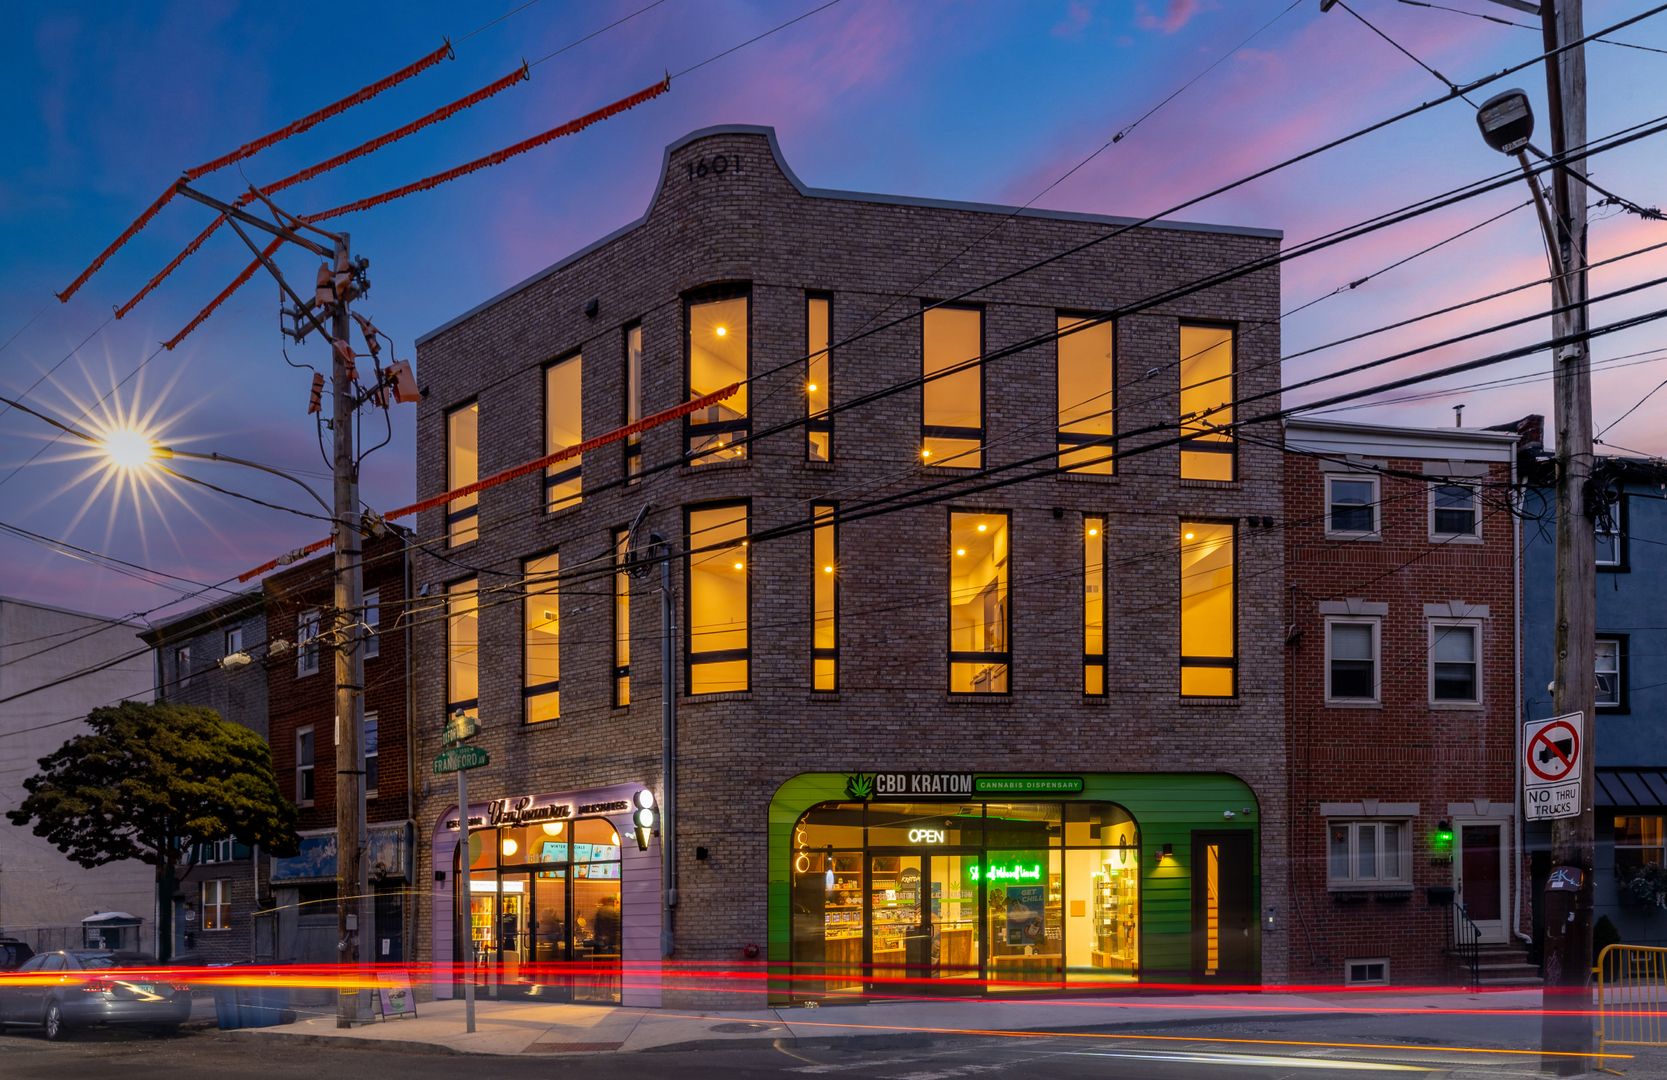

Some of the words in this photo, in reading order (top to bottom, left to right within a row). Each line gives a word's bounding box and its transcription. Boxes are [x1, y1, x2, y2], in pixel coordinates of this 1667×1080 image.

[688, 155, 740, 181] 1601
[876, 774, 906, 793] CBD
[911, 774, 973, 793] KRATOM
[1529, 790, 1551, 803] NO
[1556, 789, 1576, 801] THRU
[1534, 802, 1571, 815] TRUCKS
[908, 829, 944, 843] OPEN
